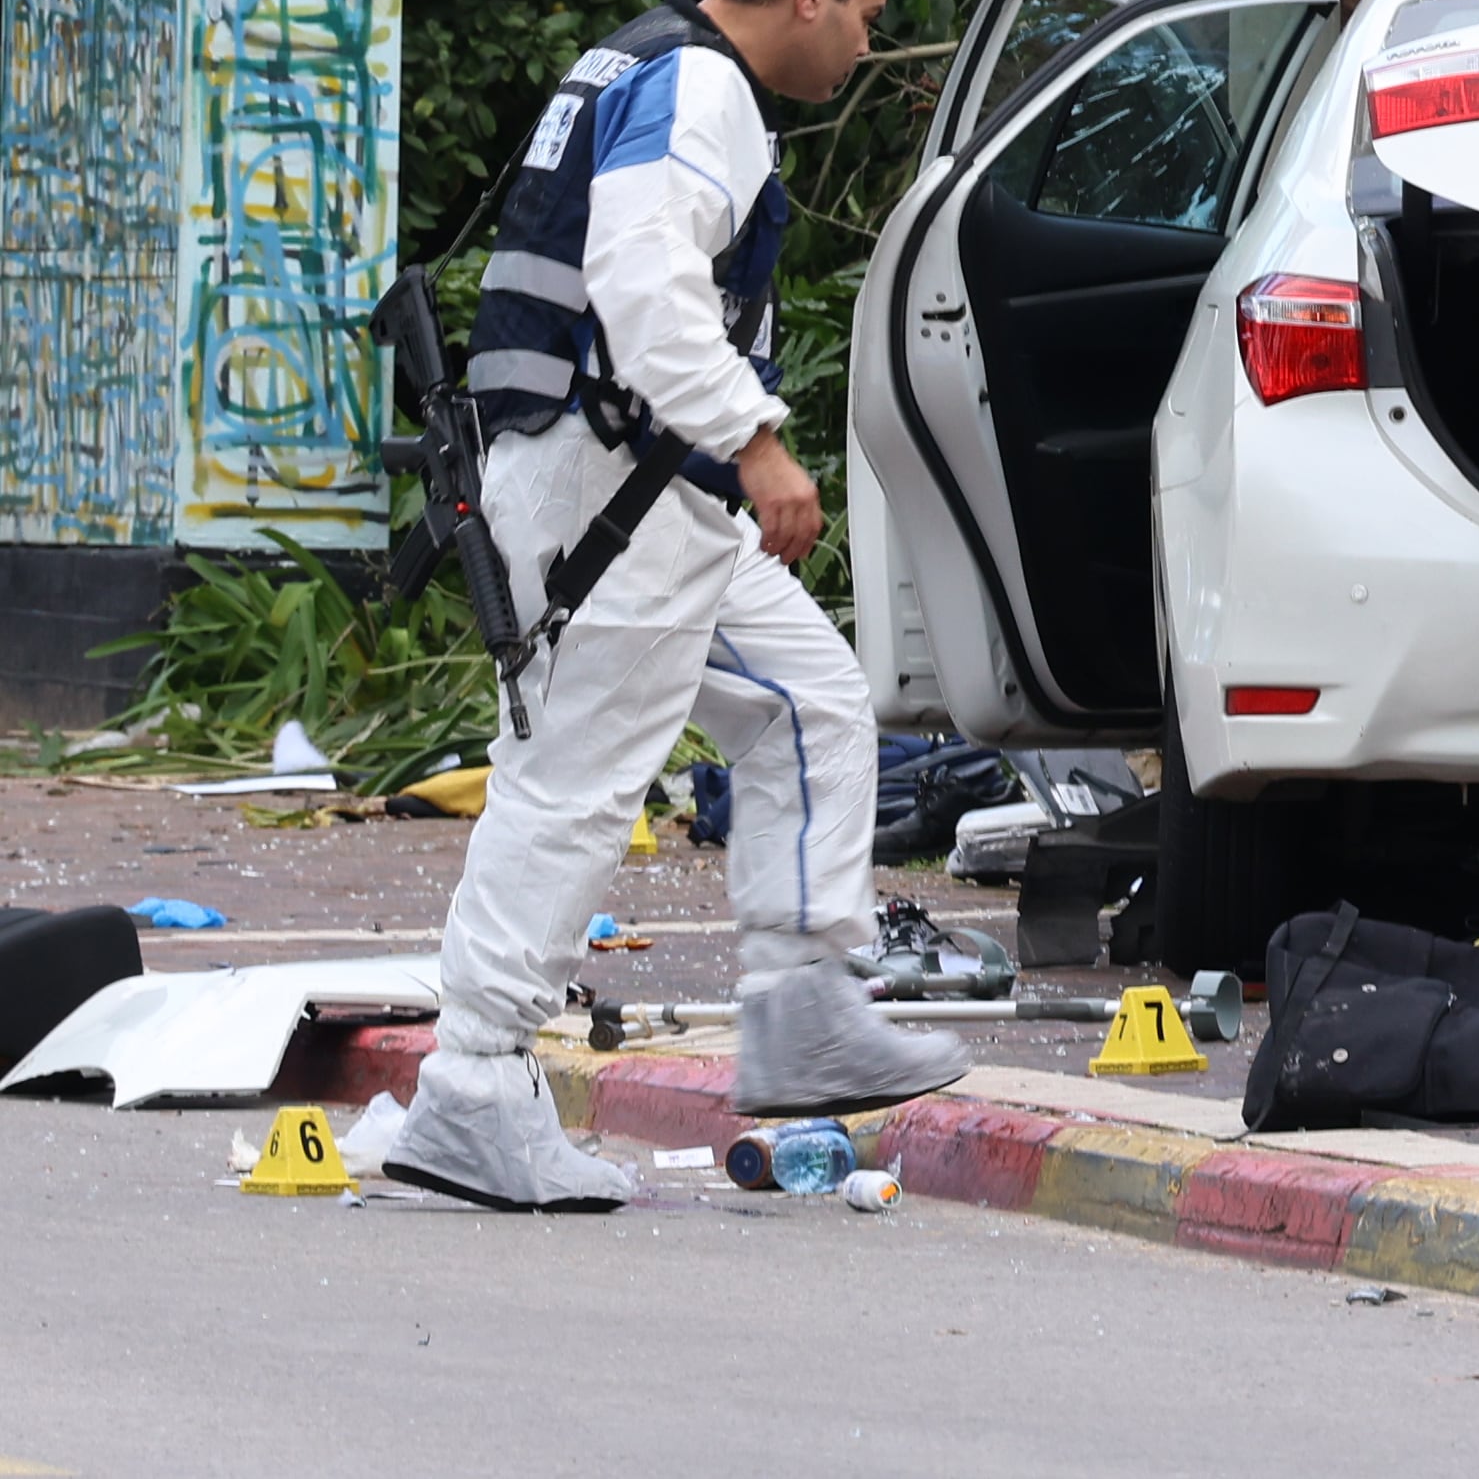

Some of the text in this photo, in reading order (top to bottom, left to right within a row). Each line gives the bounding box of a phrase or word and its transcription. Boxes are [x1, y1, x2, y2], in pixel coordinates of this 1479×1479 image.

[1118, 1014, 1128, 1041] 7
[1143, 1001, 1166, 1043] 7
[269, 1129, 280, 1158] 6
[299, 1119, 324, 1164] 6
